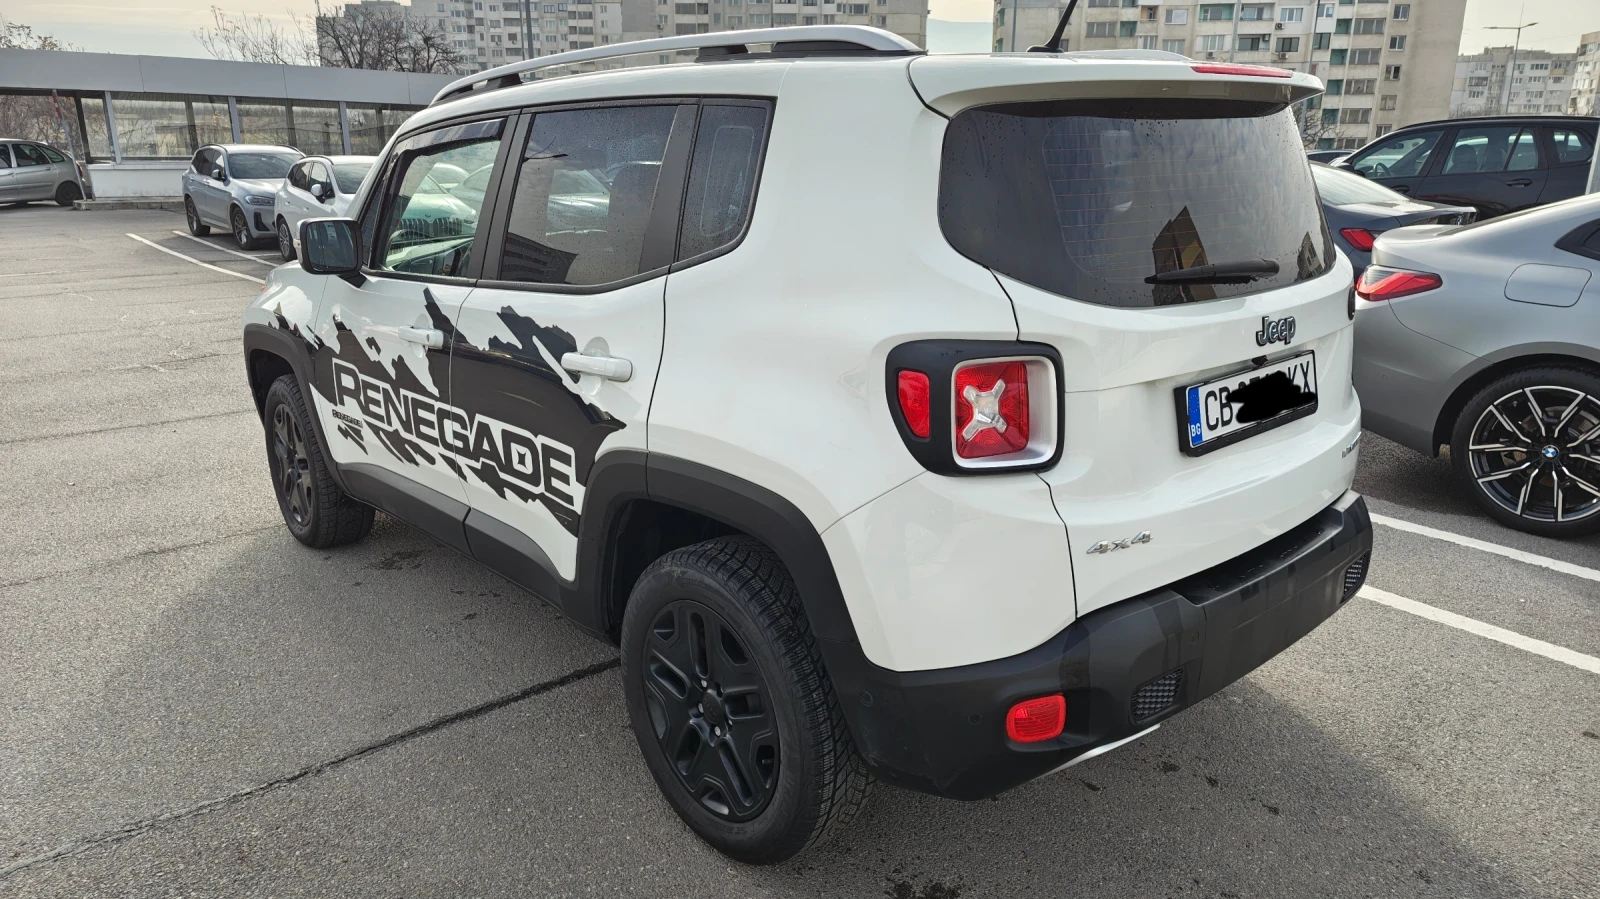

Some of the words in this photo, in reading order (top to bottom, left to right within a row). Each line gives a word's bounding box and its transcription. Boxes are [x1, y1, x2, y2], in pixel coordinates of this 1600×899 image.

[1256, 316, 1296, 346] Jeep
[333, 359, 576, 507] RENEGADE
[1190, 423, 1201, 437] BG
[1086, 530, 1153, 554] 4x4
